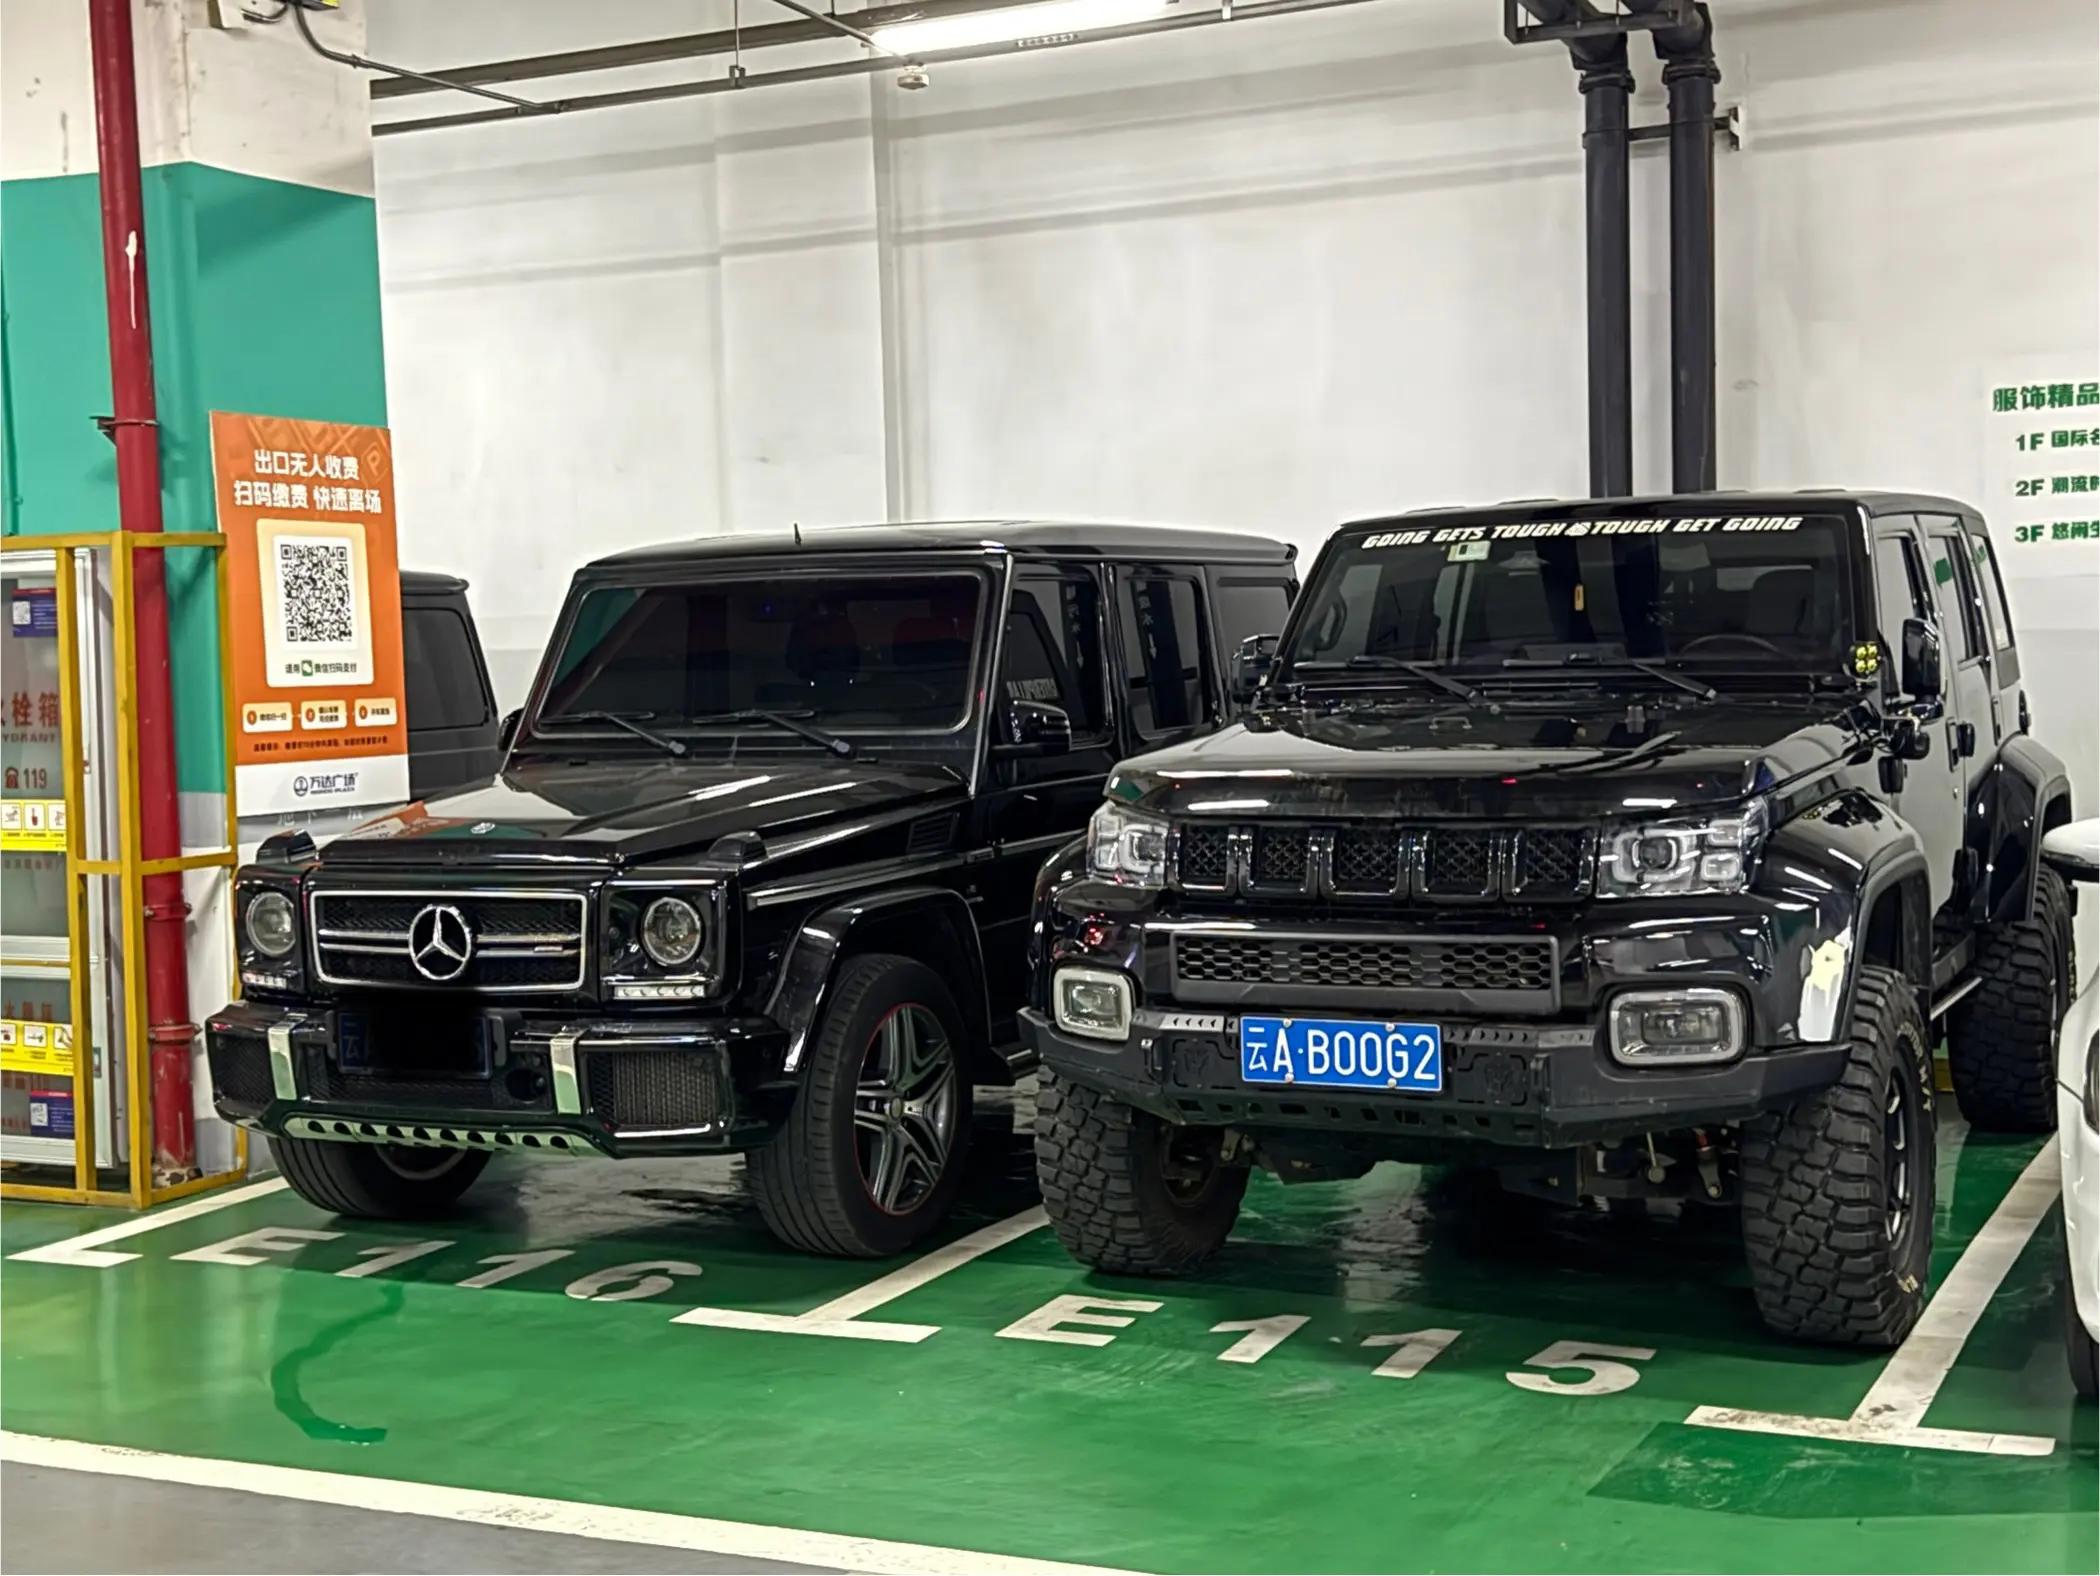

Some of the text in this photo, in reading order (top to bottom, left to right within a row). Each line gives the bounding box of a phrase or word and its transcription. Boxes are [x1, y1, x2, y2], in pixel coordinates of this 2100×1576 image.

[1993, 383, 2099, 412] 服饰精品
[2016, 433, 2045, 451] 1F
[254, 449, 360, 481] 出口无人收费
[233, 480, 383, 514] 扫码缴费 快速离场
[2015, 479, 2045, 497] 2F
[1361, 517, 1804, 550] GOING GETS TOUGH TOUGH GET GOING
[2014, 525, 2045, 542] 3F
[1, 692, 60, 728] 栓箱
[23, 768, 47, 789] 119
[309, 773, 356, 789] 万达广场
[169, 1226, 703, 1301] E116
[994, 1294, 1657, 1396] E115
